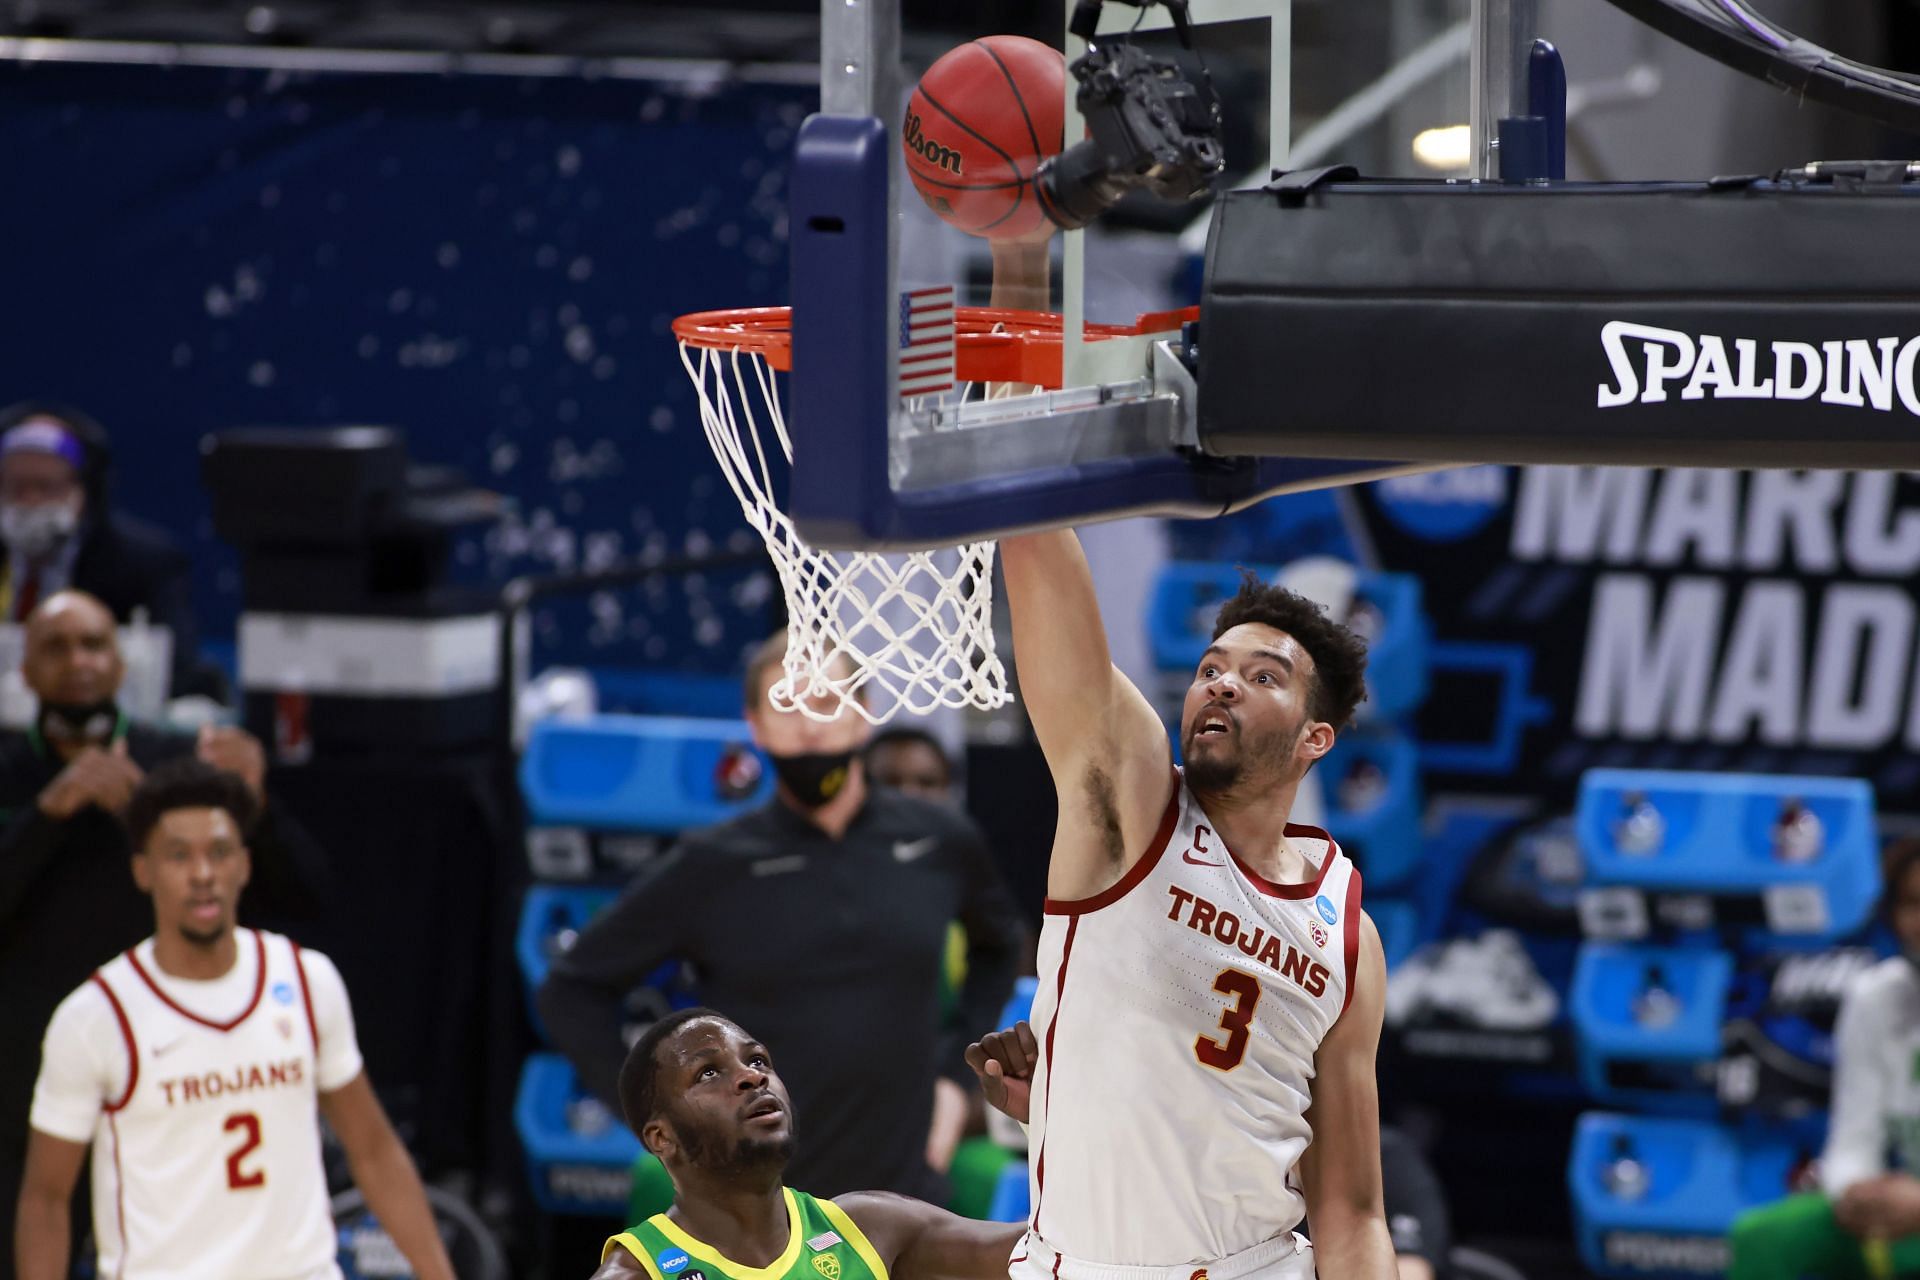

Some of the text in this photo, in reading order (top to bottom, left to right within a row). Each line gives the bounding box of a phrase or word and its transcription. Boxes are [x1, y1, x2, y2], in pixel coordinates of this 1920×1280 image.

[902, 101, 962, 175] ilson
[1572, 573, 1920, 755] MAD
[1193, 824, 1210, 854] C
[1166, 884, 1331, 999] TROJANS
[1192, 967, 1263, 1073] 3
[160, 1056, 304, 1106] TROJANS
[222, 1108, 266, 1193] 2
[661, 1255, 688, 1270] NCAA
